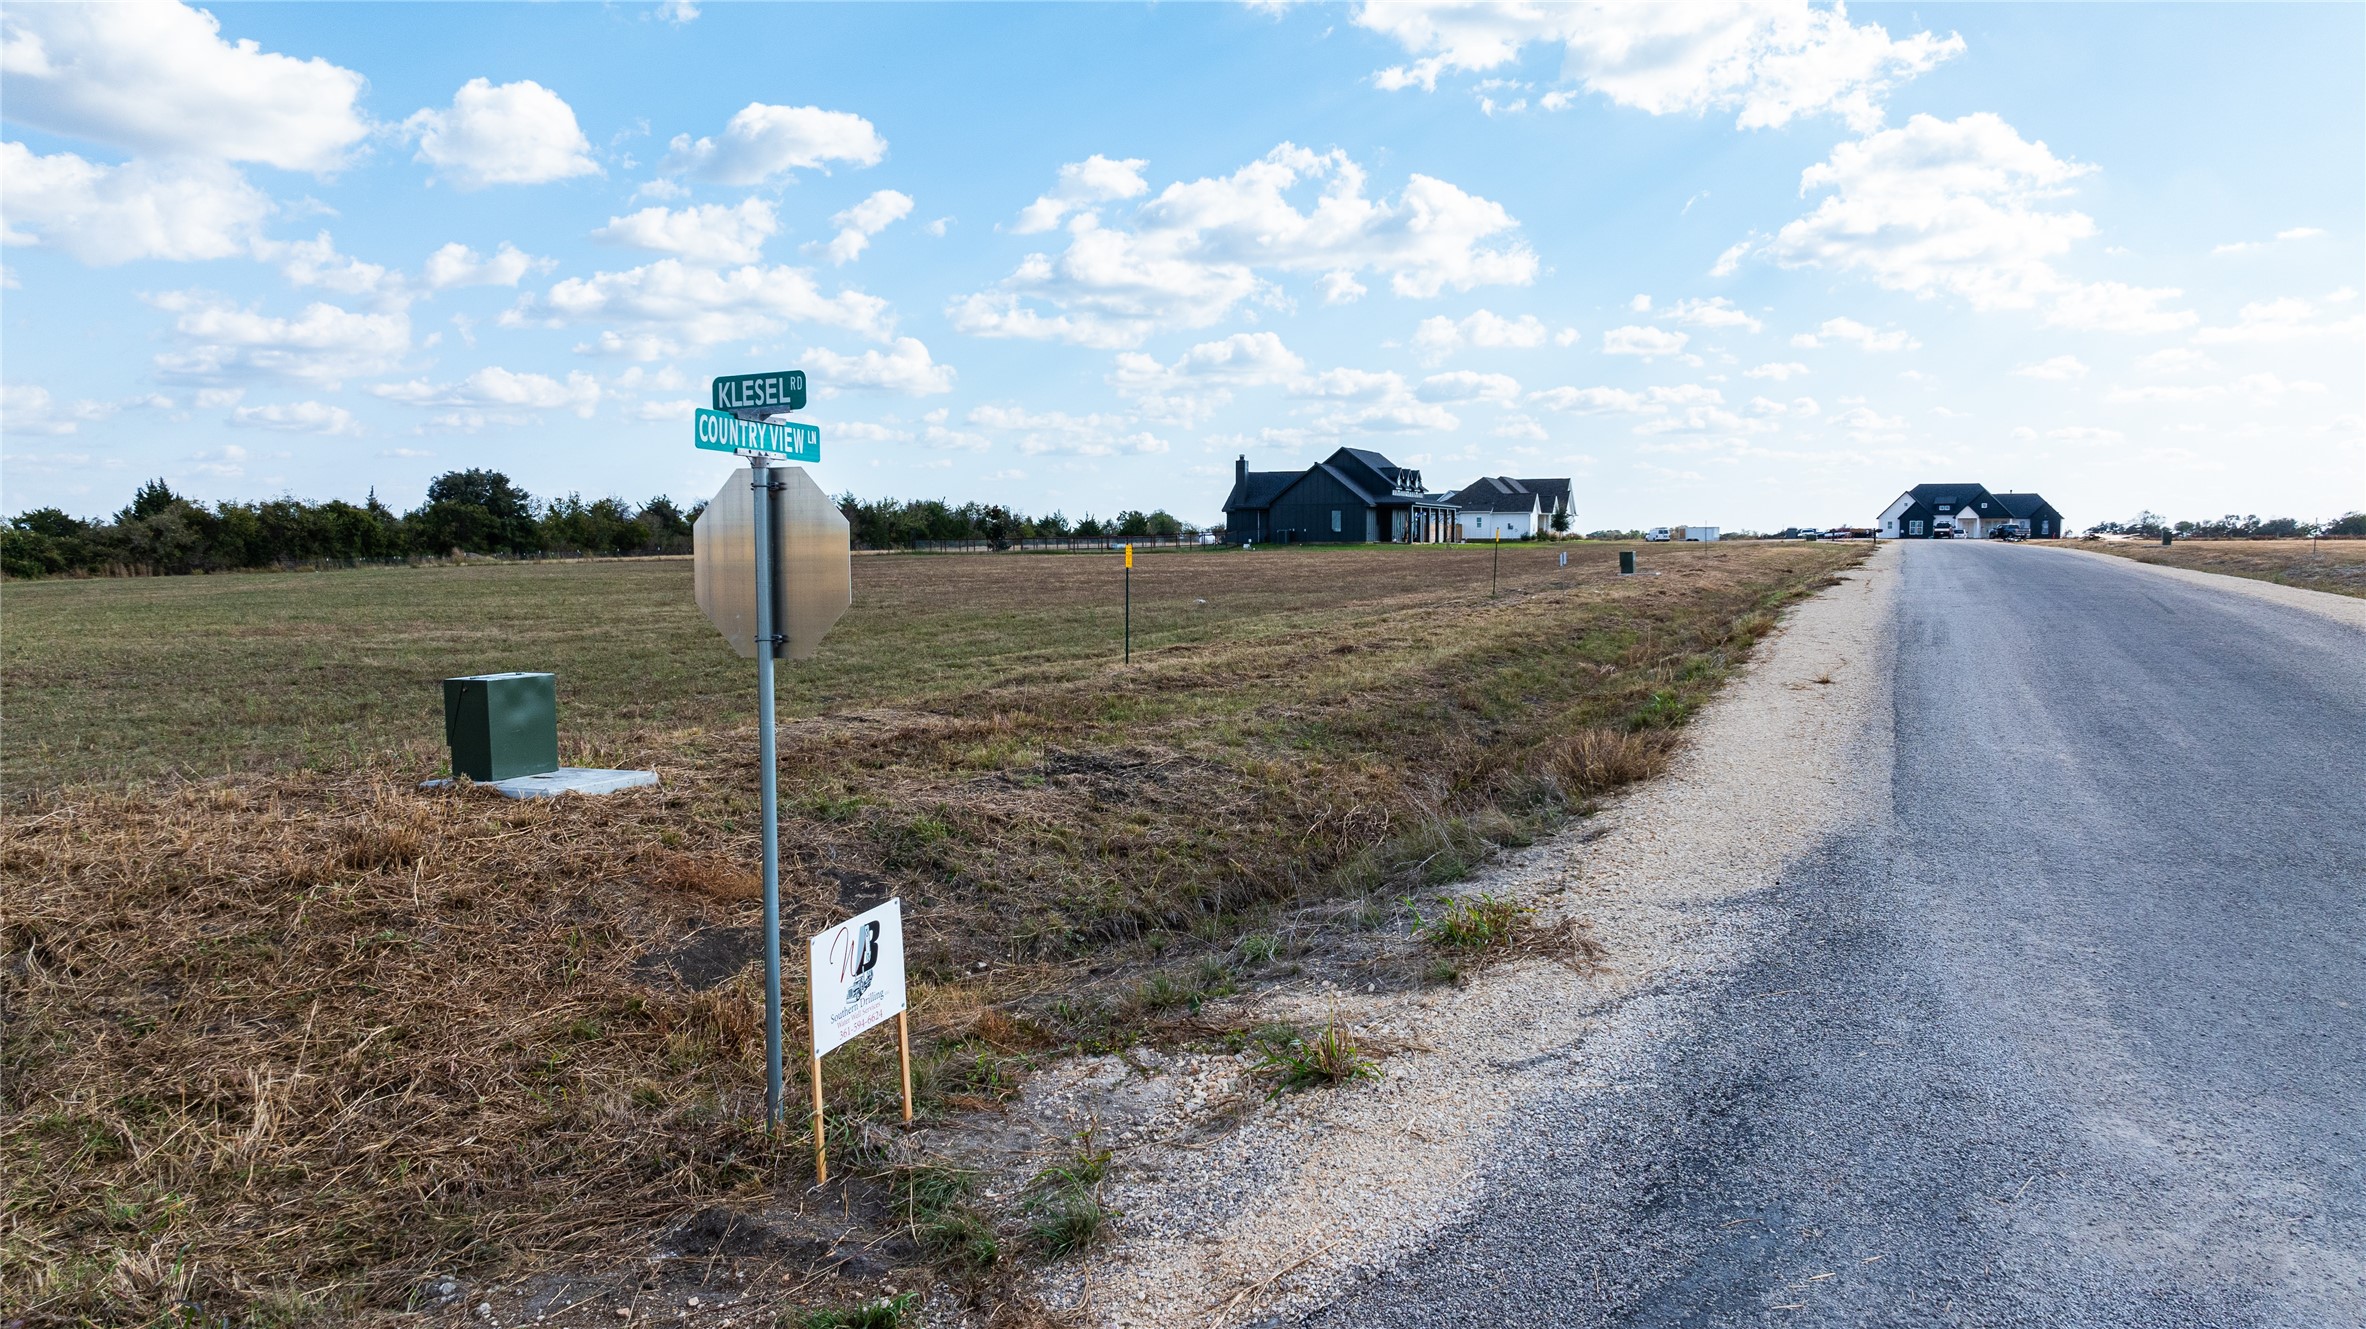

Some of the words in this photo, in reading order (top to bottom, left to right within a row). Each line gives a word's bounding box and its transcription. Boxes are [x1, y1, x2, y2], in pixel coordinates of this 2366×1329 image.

[718, 377, 791, 408] KLESEL
[790, 376, 803, 390] RD
[699, 414, 766, 449] COUNTRY
[769, 425, 804, 454] VIEW
[807, 430, 817, 444] LN
[830, 1003, 859, 1024] Southern
[860, 989, 884, 1007] Drilling
